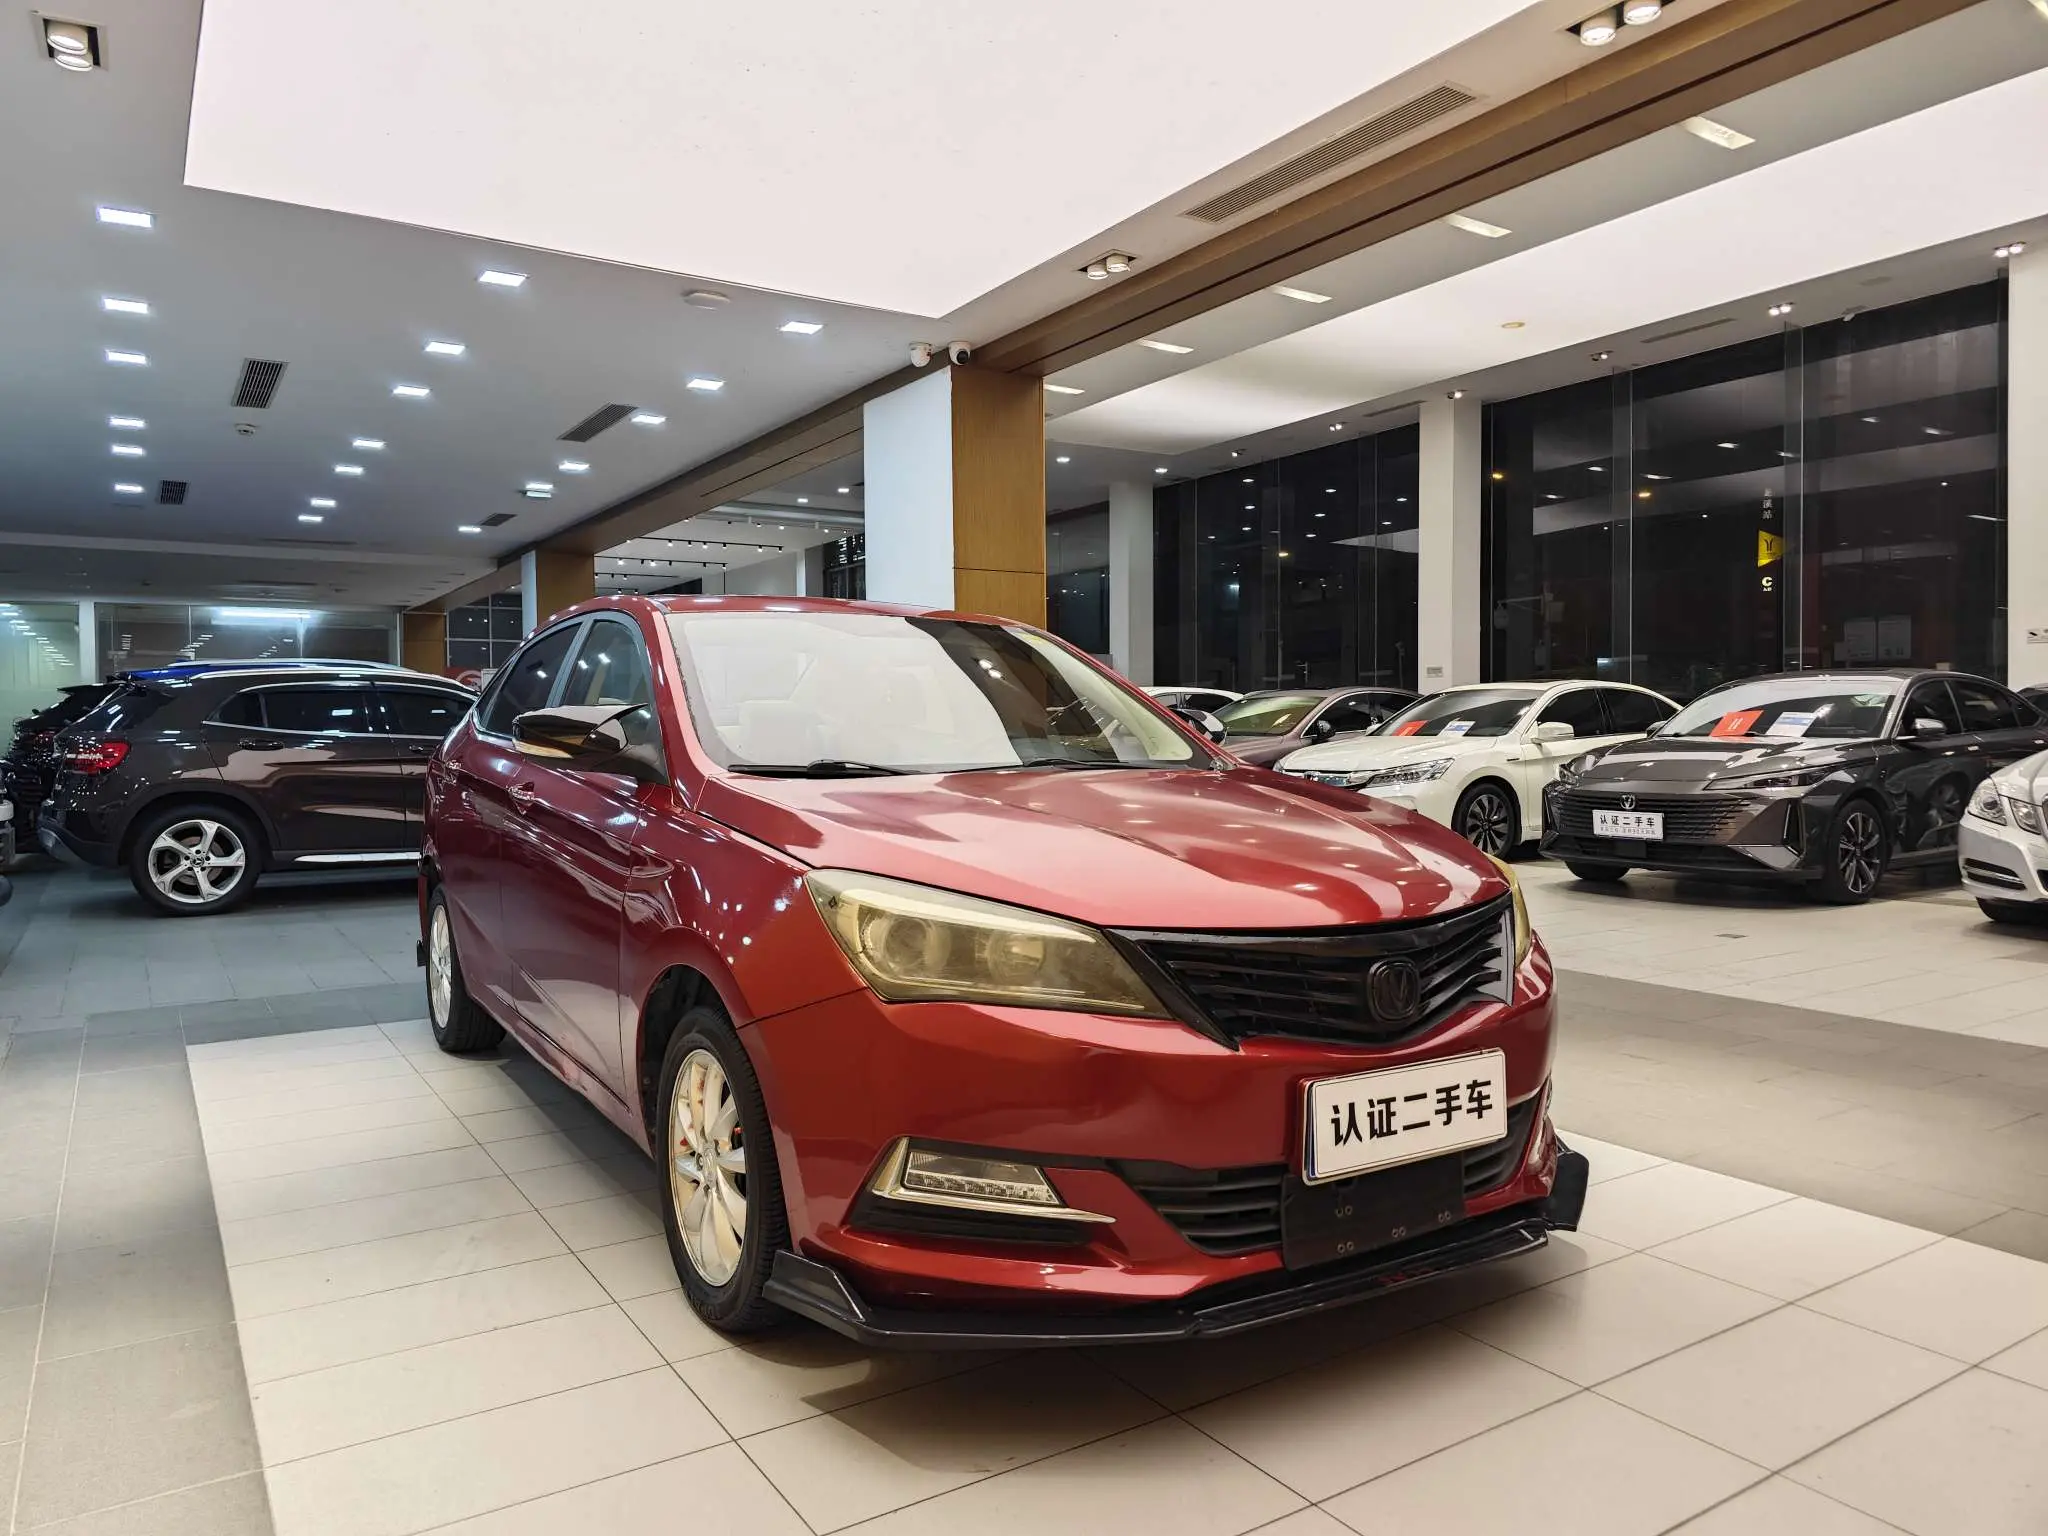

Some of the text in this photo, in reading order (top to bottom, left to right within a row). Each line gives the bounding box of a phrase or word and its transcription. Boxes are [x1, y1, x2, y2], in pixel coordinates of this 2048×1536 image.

[1600, 814, 1656, 828] 认证二手车
[1331, 1079, 1493, 1147] 认证二手车
